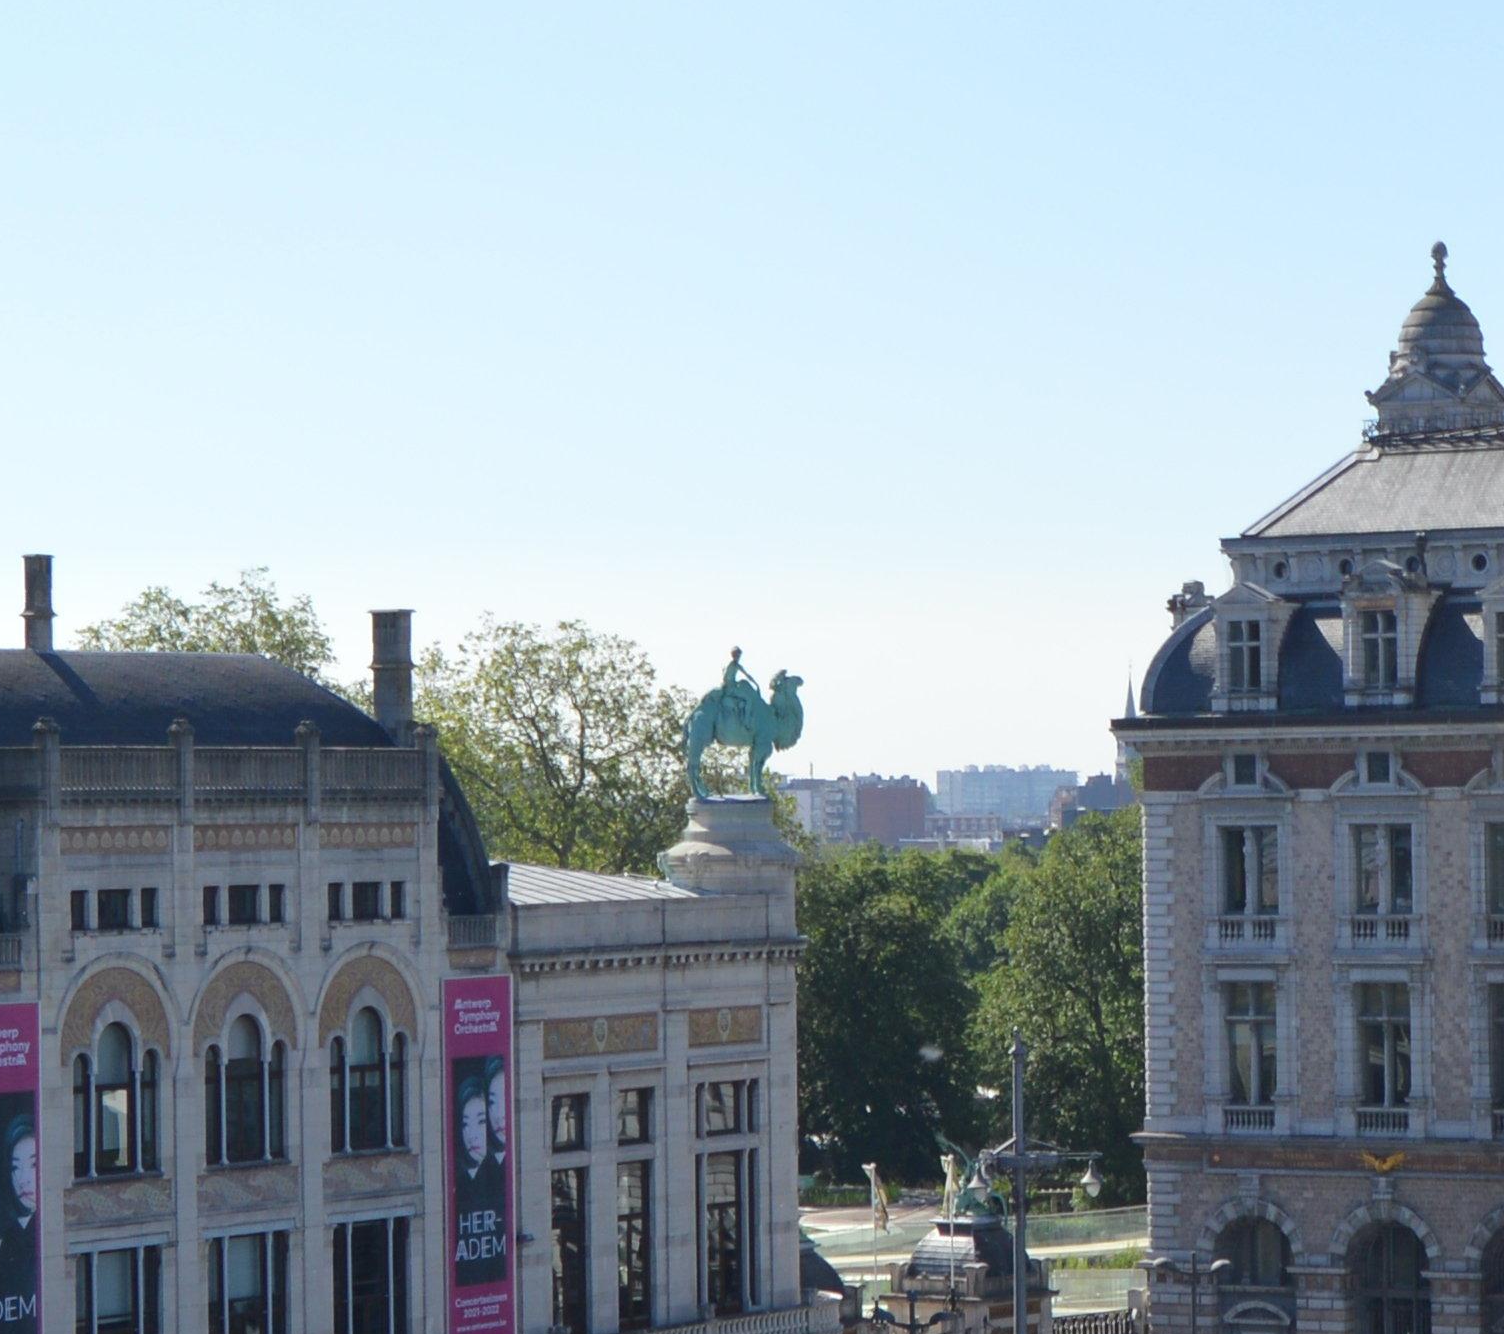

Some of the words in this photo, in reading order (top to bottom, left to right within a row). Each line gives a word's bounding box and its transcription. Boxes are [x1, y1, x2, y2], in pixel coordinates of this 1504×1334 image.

[459, 1011, 500, 1024] Symphony
[459, 1210, 502, 1235] HER-
[455, 1234, 507, 1262] ADEM
[464, 1304, 500, 1318] 2021-2022
